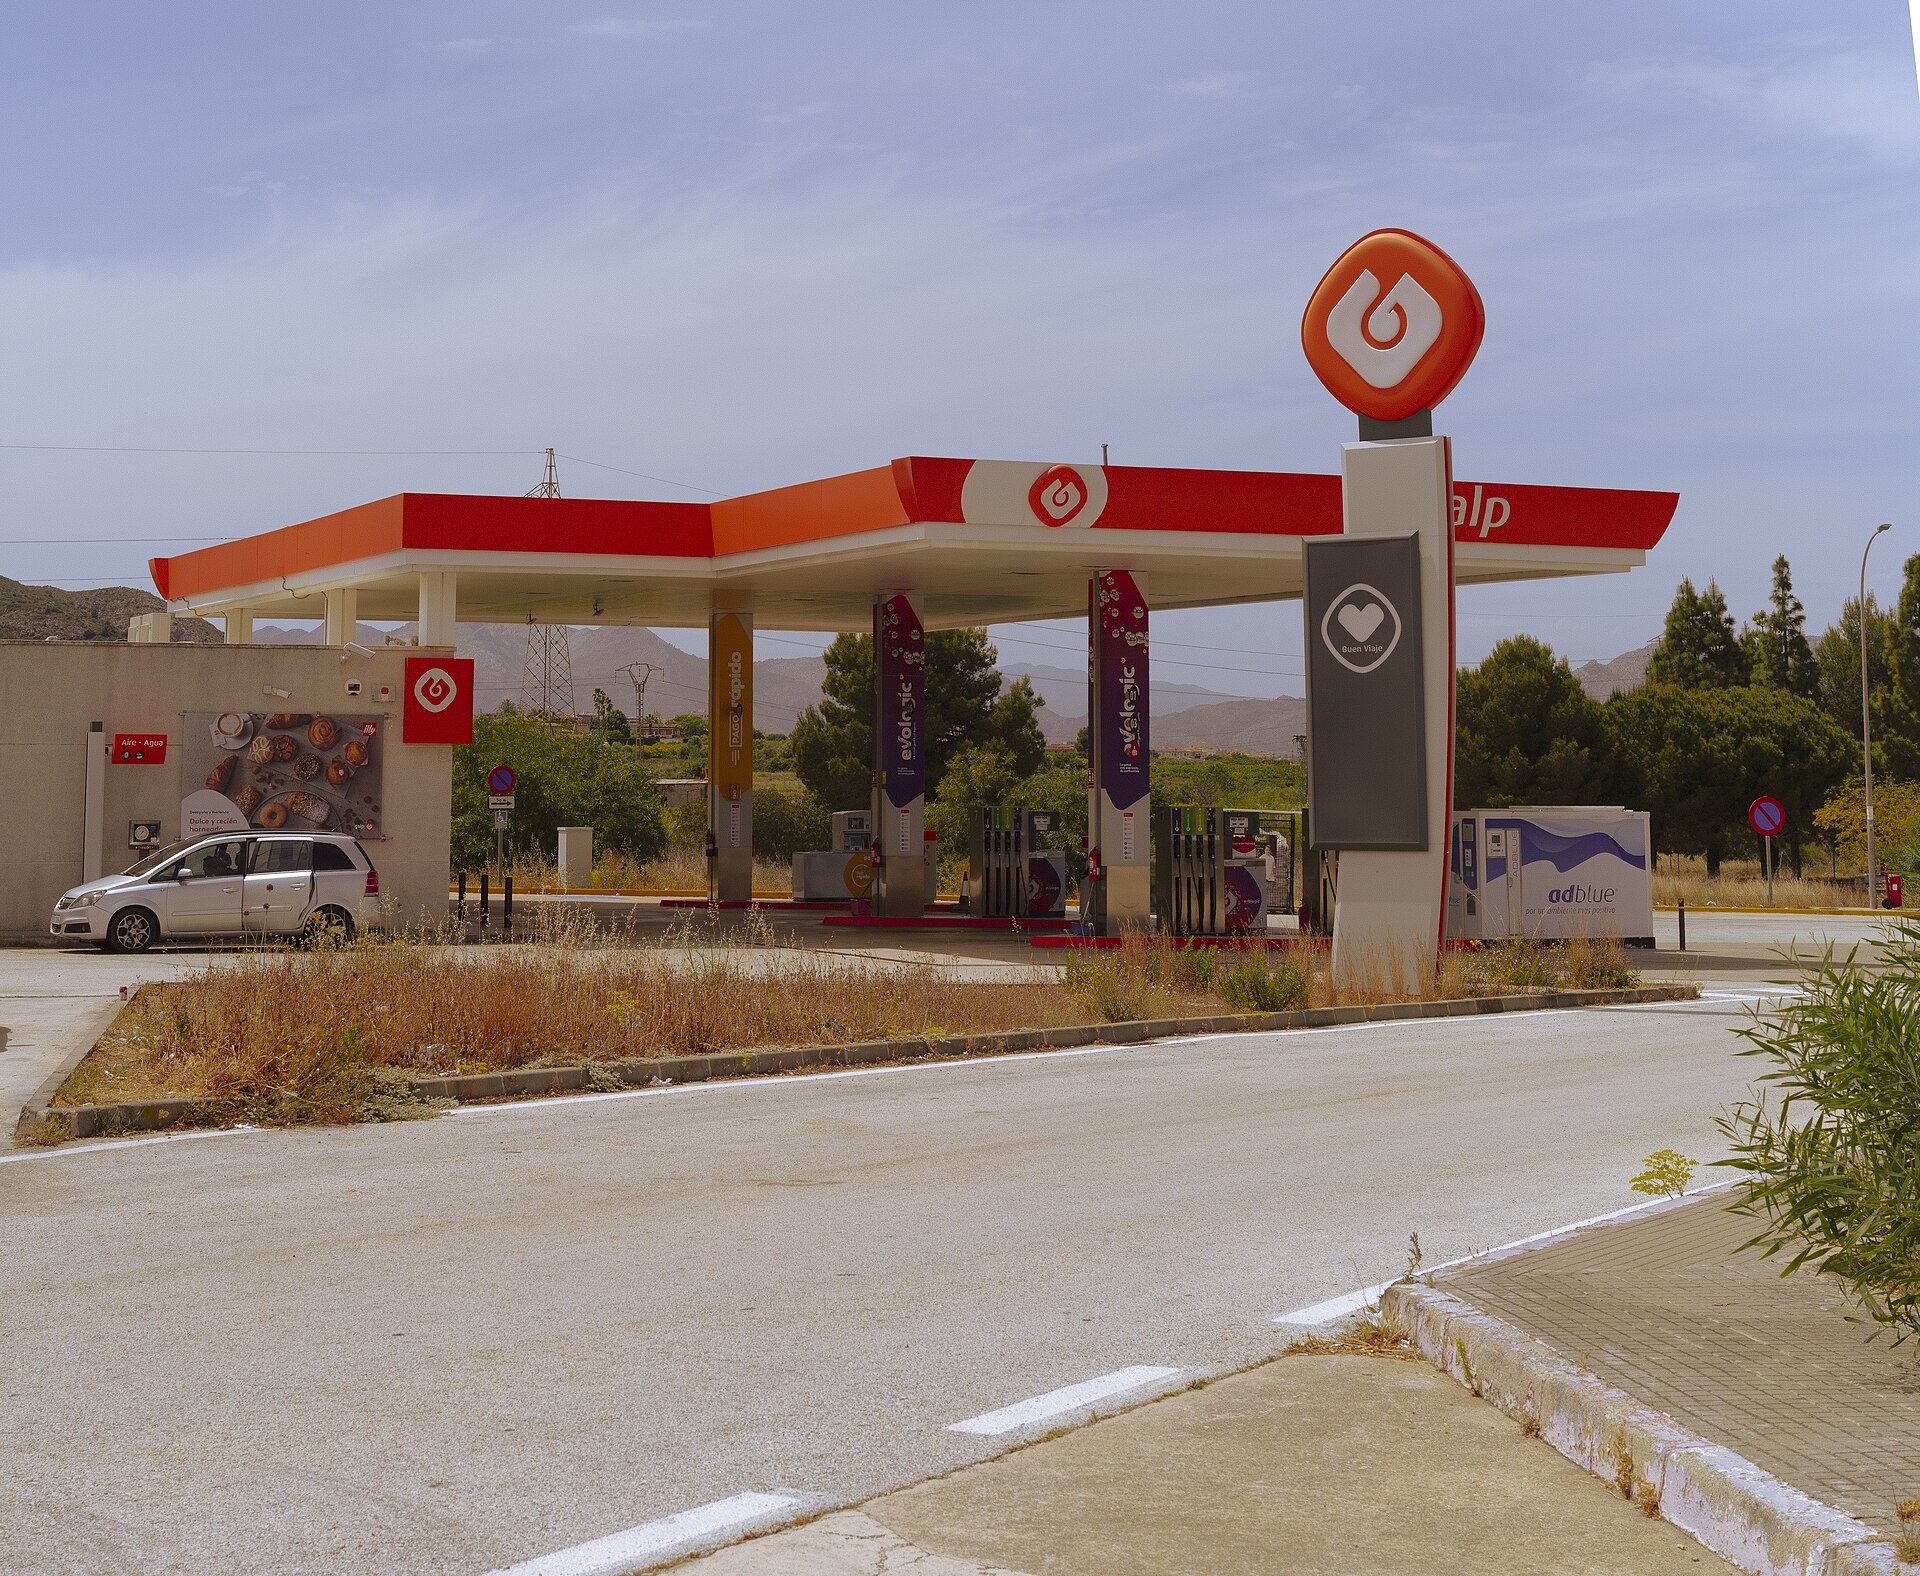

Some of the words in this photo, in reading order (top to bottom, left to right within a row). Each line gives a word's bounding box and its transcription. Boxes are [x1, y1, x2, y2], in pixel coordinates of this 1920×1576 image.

[1453, 485, 1511, 538] alp
[1342, 645, 1362, 653] Buen
[1363, 644, 1383, 654] Viaje
[727, 651, 745, 707] rápido
[363, 724, 376, 736] illy
[732, 715, 741, 744] PAGO
[143, 739, 164, 748] Agua
[216, 817, 238, 825] recién
[189, 825, 224, 833] horneado
[1511, 830, 1519, 878] ADBLUE
[1548, 884, 1615, 904] adblue
[1525, 908, 1536, 916] por
